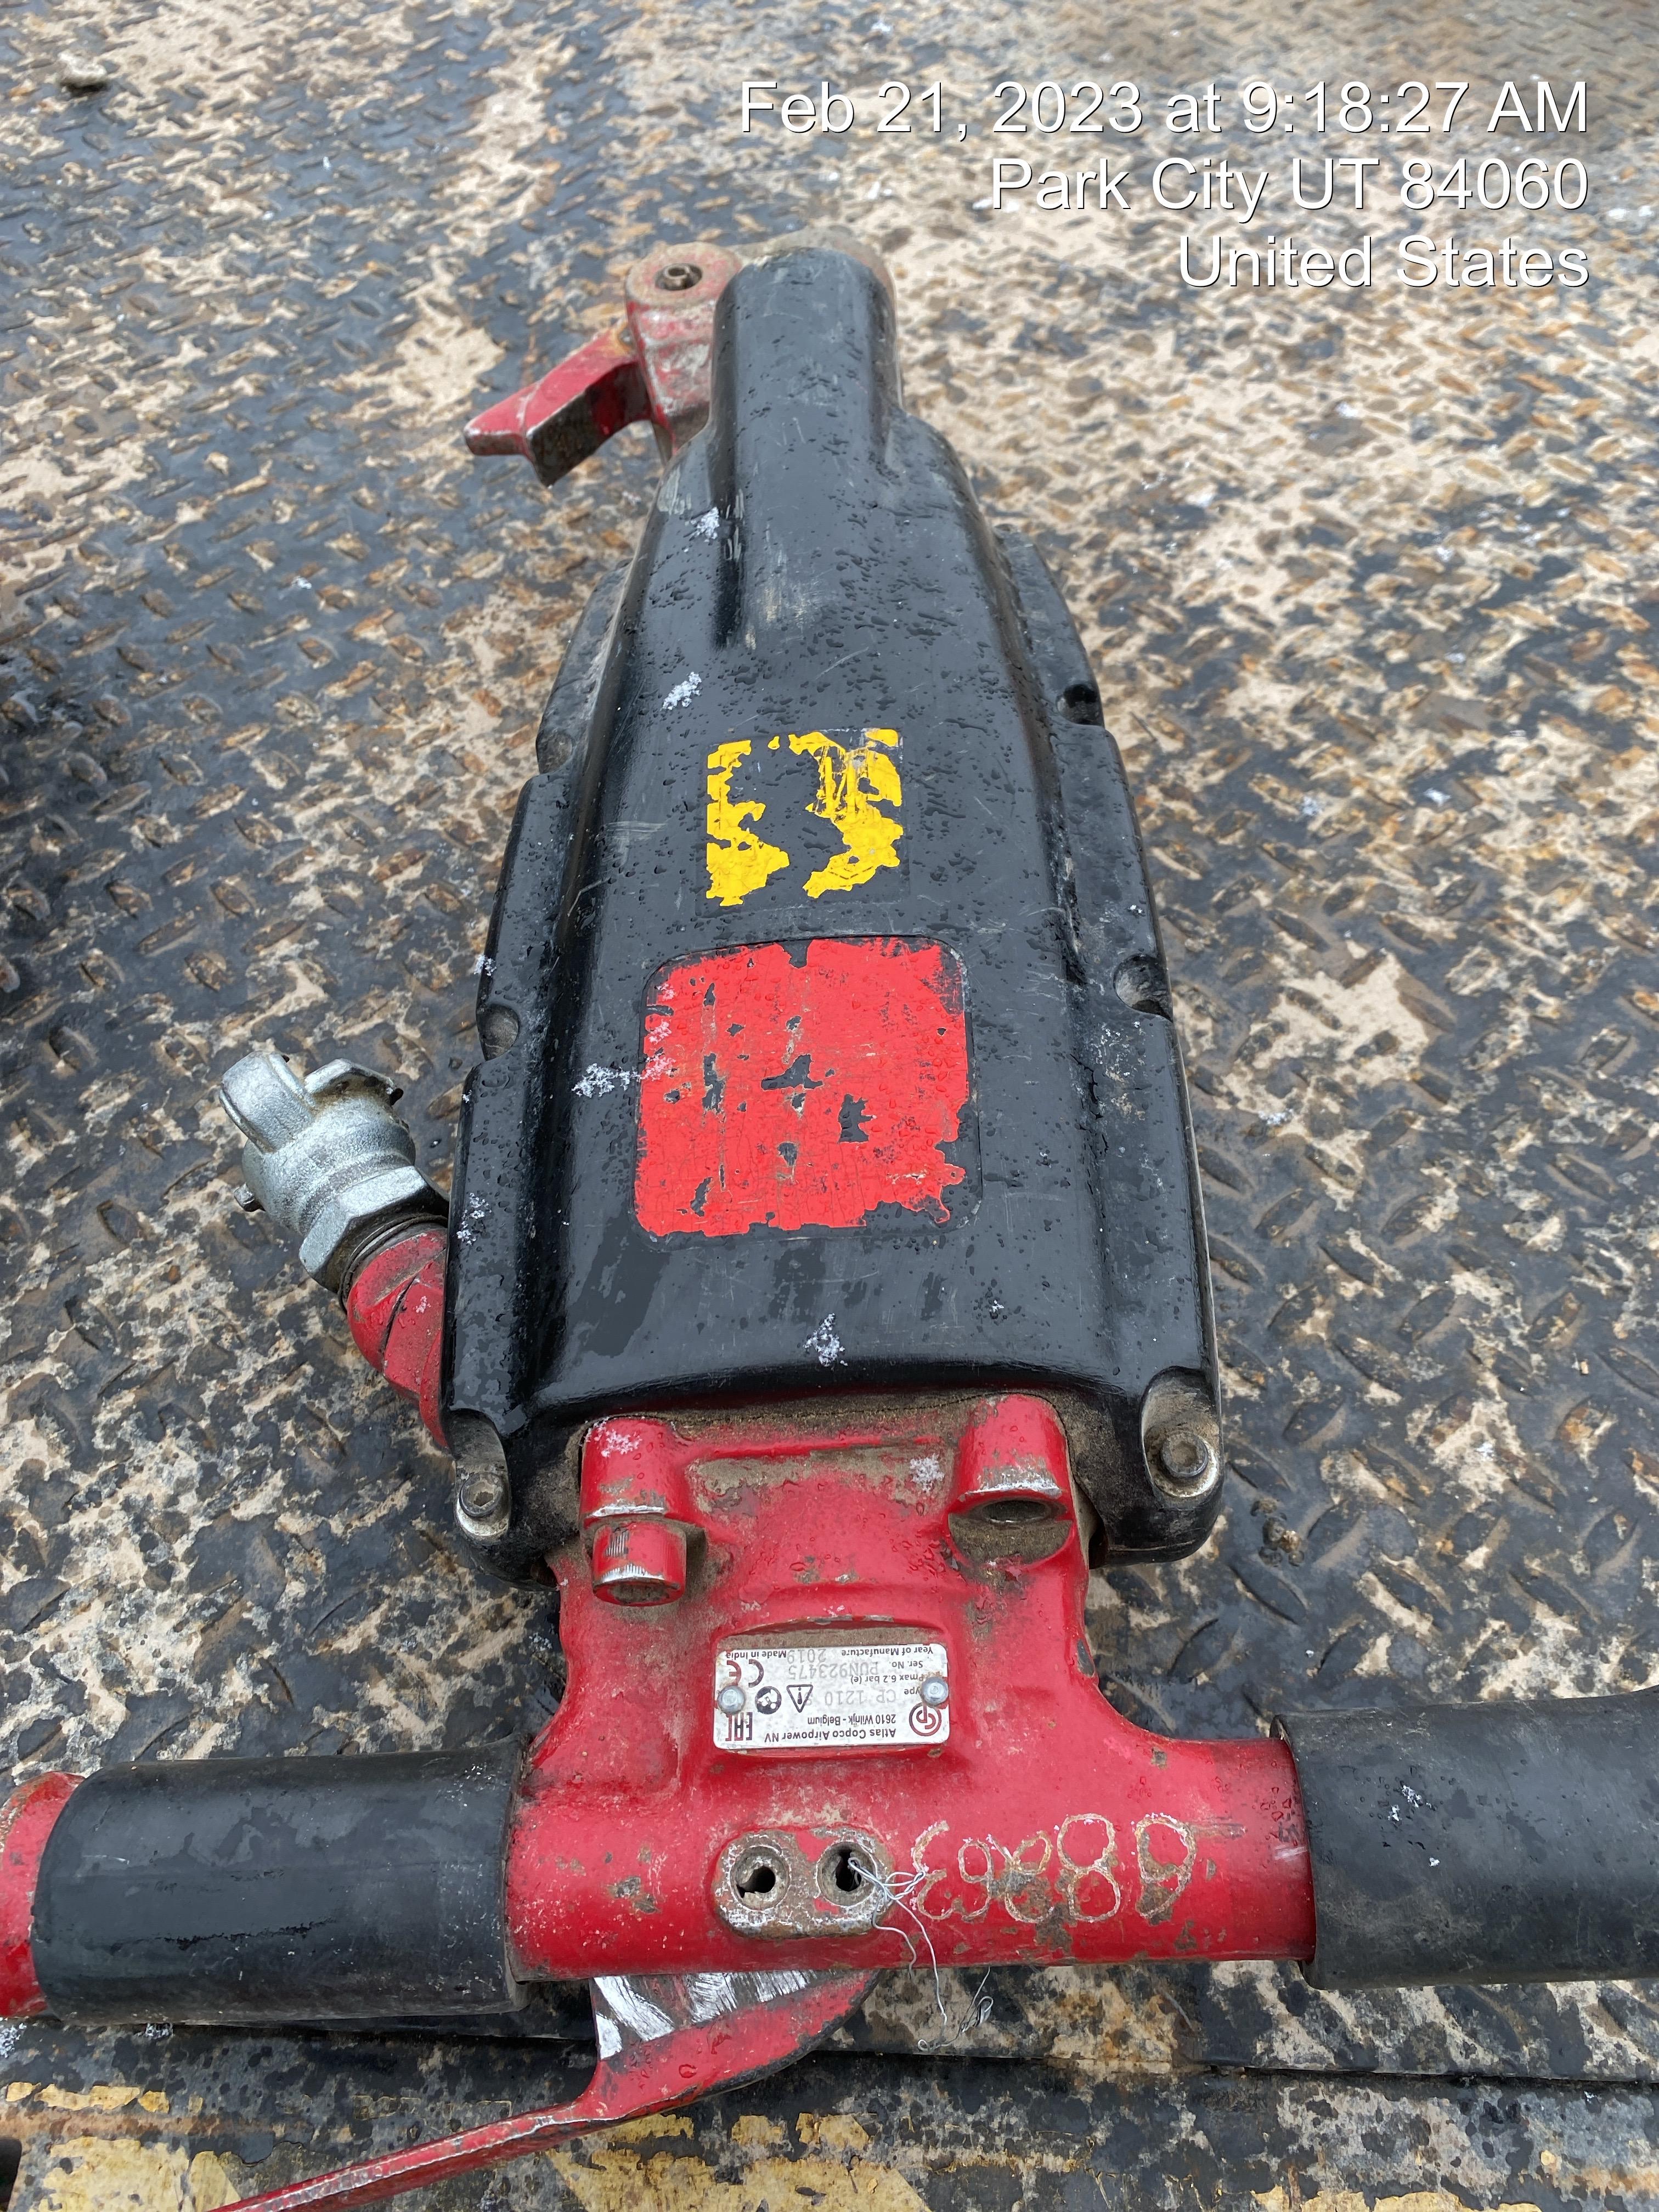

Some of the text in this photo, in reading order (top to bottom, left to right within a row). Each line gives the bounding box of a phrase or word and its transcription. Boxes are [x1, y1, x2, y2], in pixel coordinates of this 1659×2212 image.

[762, 1650, 786, 1659] Made
[787, 1649, 826, 1663] 2019
[842, 1647, 899, 1657] Manufacture
[902, 1647, 911, 1656] of
[788, 1662, 878, 1679] PUN923475
[851, 1675, 862, 1684] (e)
[825, 1690, 867, 1706] 1210
[876, 1690, 896, 1703] CP
[808, 1715, 840, 1726] Belgium
[876, 1714, 896, 1724] 2610
[764, 1728, 896, 1742] Atlas Copco Airpower NV
